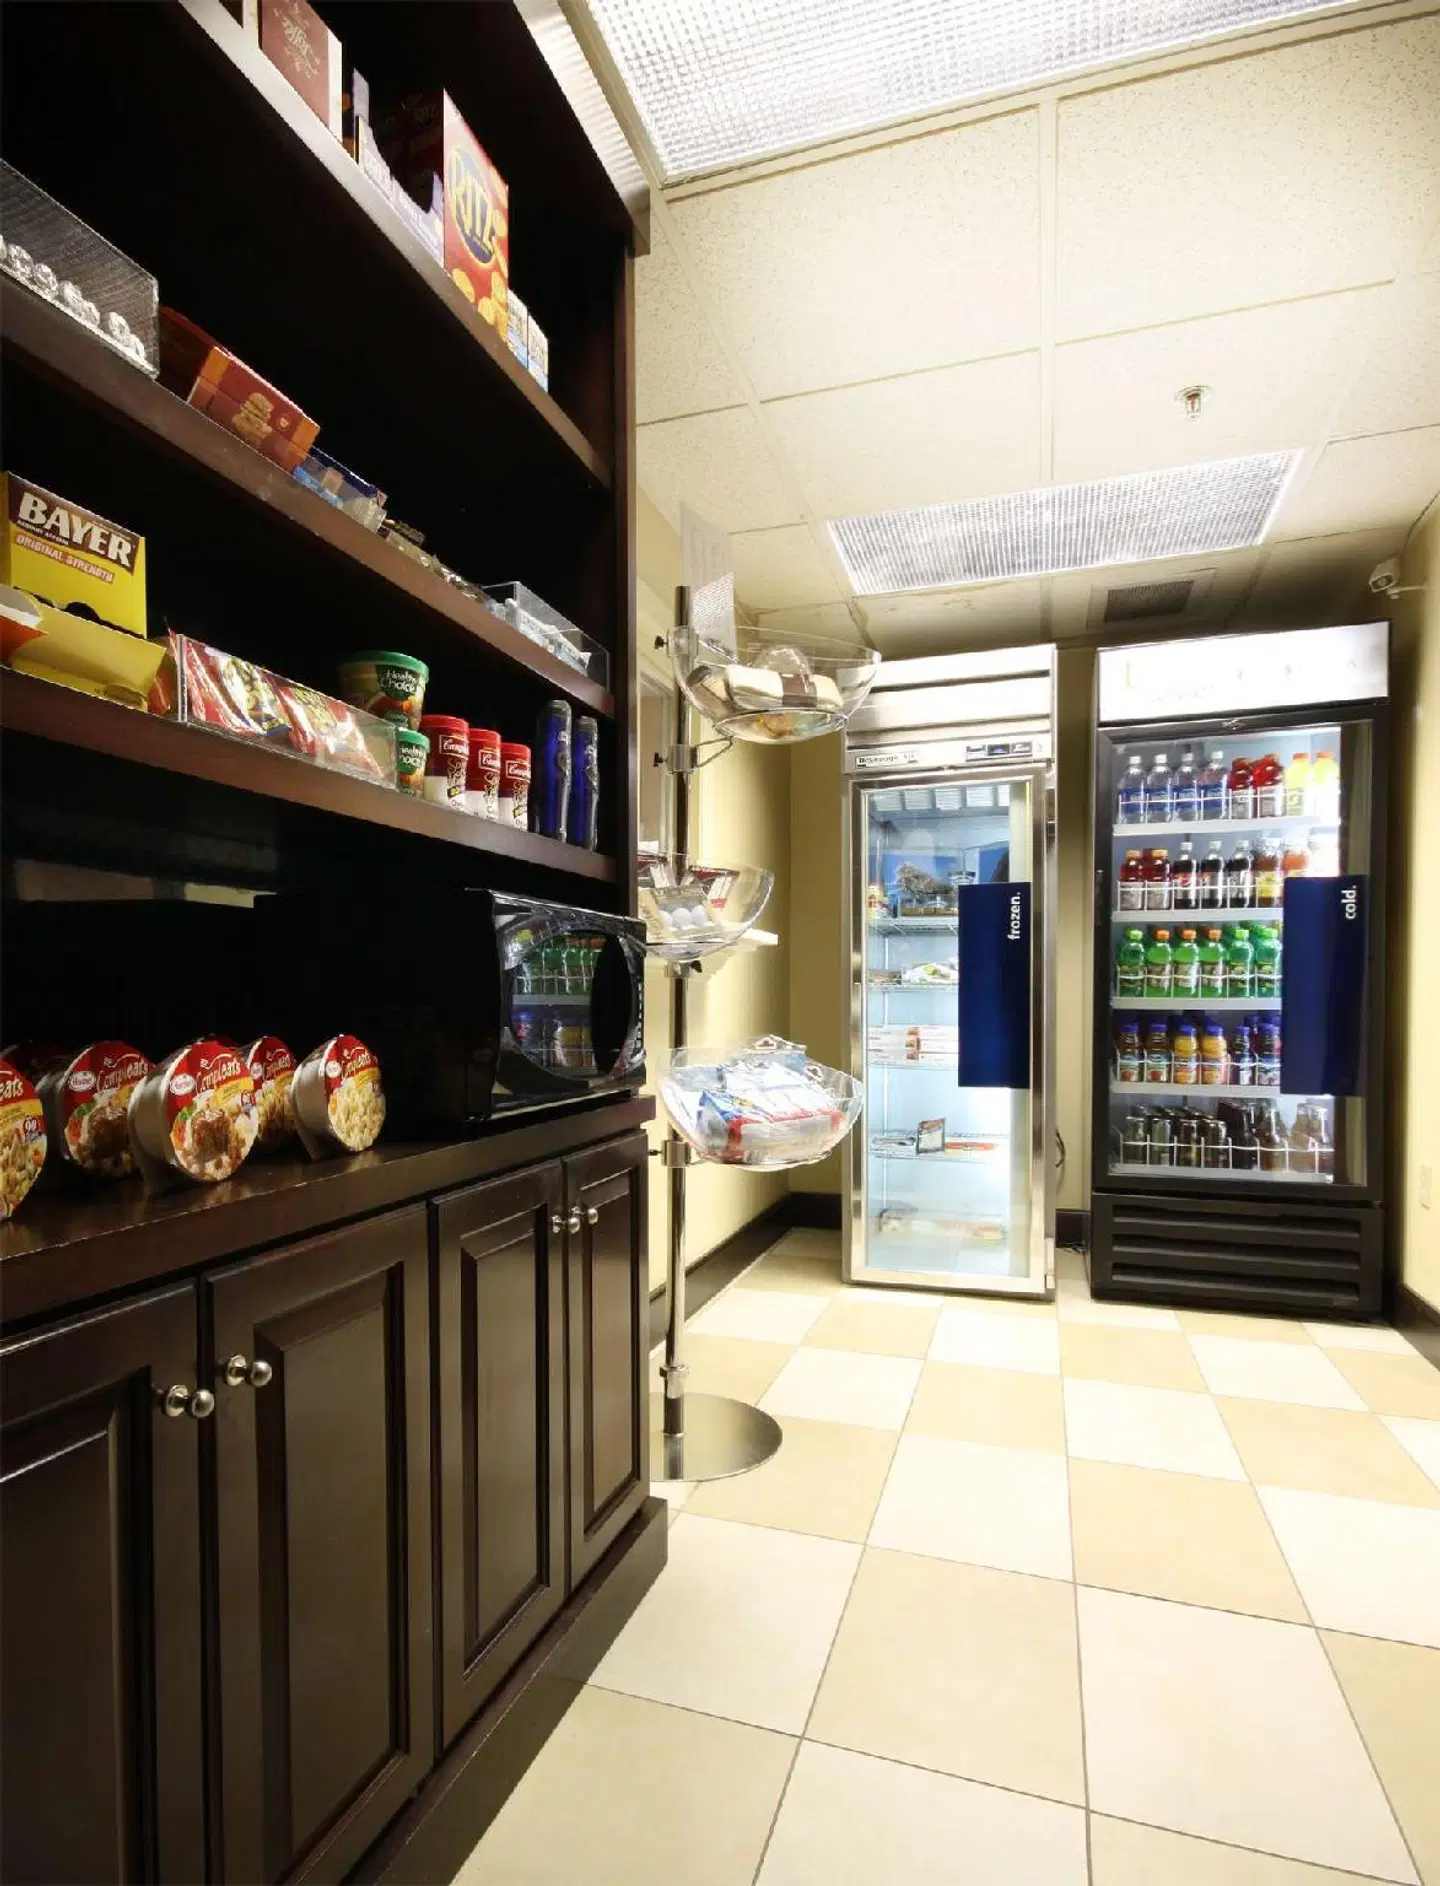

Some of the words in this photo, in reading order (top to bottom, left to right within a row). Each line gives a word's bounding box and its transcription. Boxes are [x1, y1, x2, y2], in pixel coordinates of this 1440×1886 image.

[449, 147, 495, 255] RITZ
[18, 491, 132, 568] BAYER
[15, 534, 64, 562] ORIGINAL
[65, 555, 114, 582] STRENGTH
[1007, 891, 1021, 940] frozen.
[1340, 885, 1357, 920] cold.
[196, 1057, 241, 1095] Compleats
